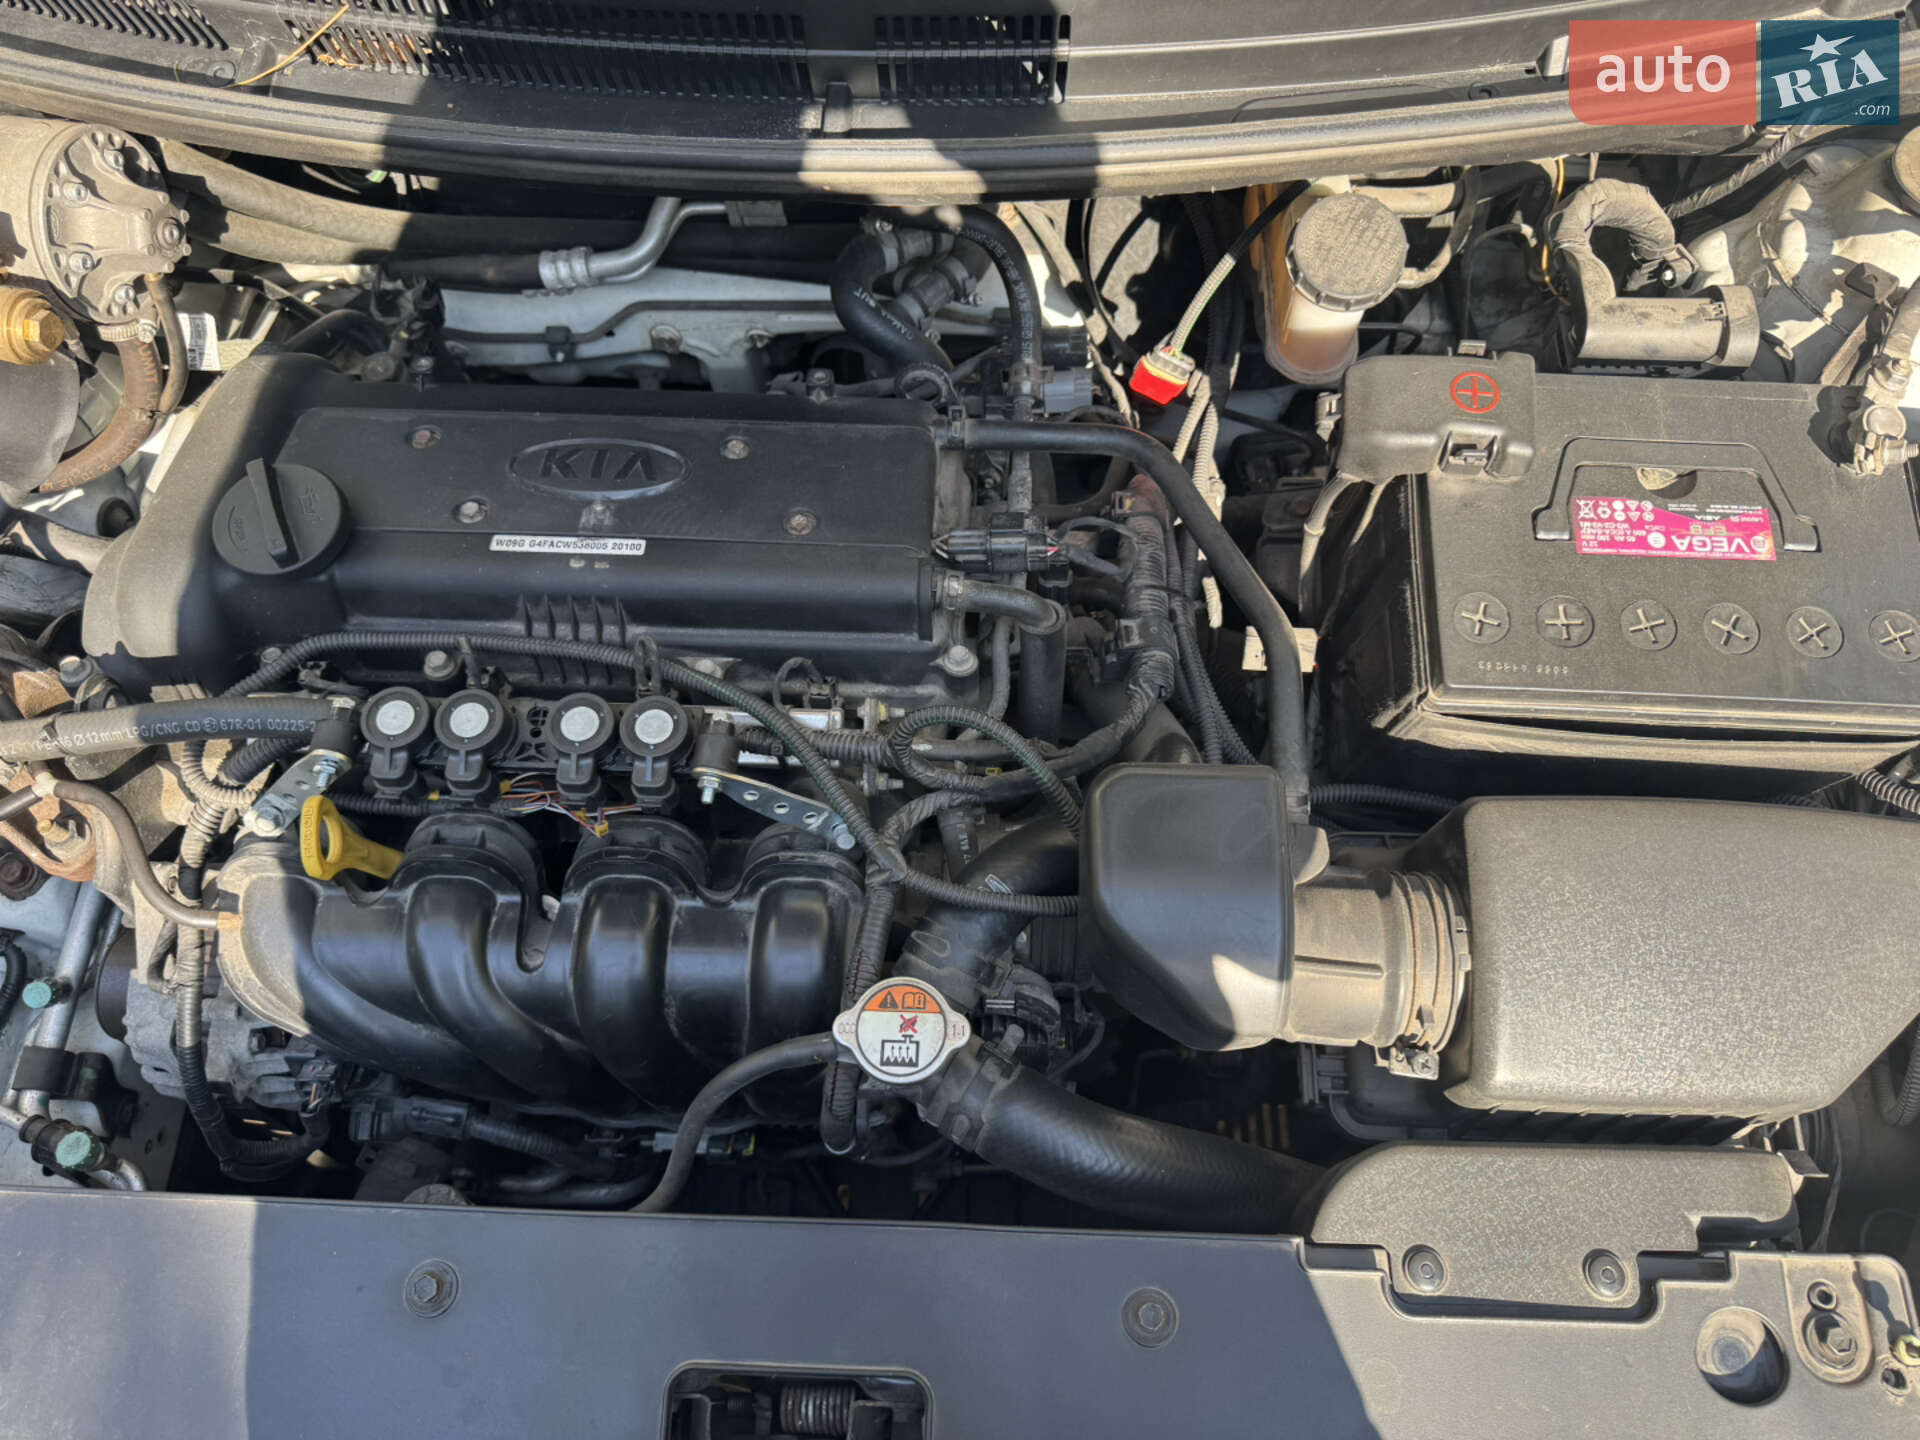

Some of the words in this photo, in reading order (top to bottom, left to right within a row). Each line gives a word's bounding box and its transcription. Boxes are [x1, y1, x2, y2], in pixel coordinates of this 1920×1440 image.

[539, 449, 657, 481] KIA
[1690, 524, 1727, 535] EFB
[1671, 535, 1750, 553] VEGA
